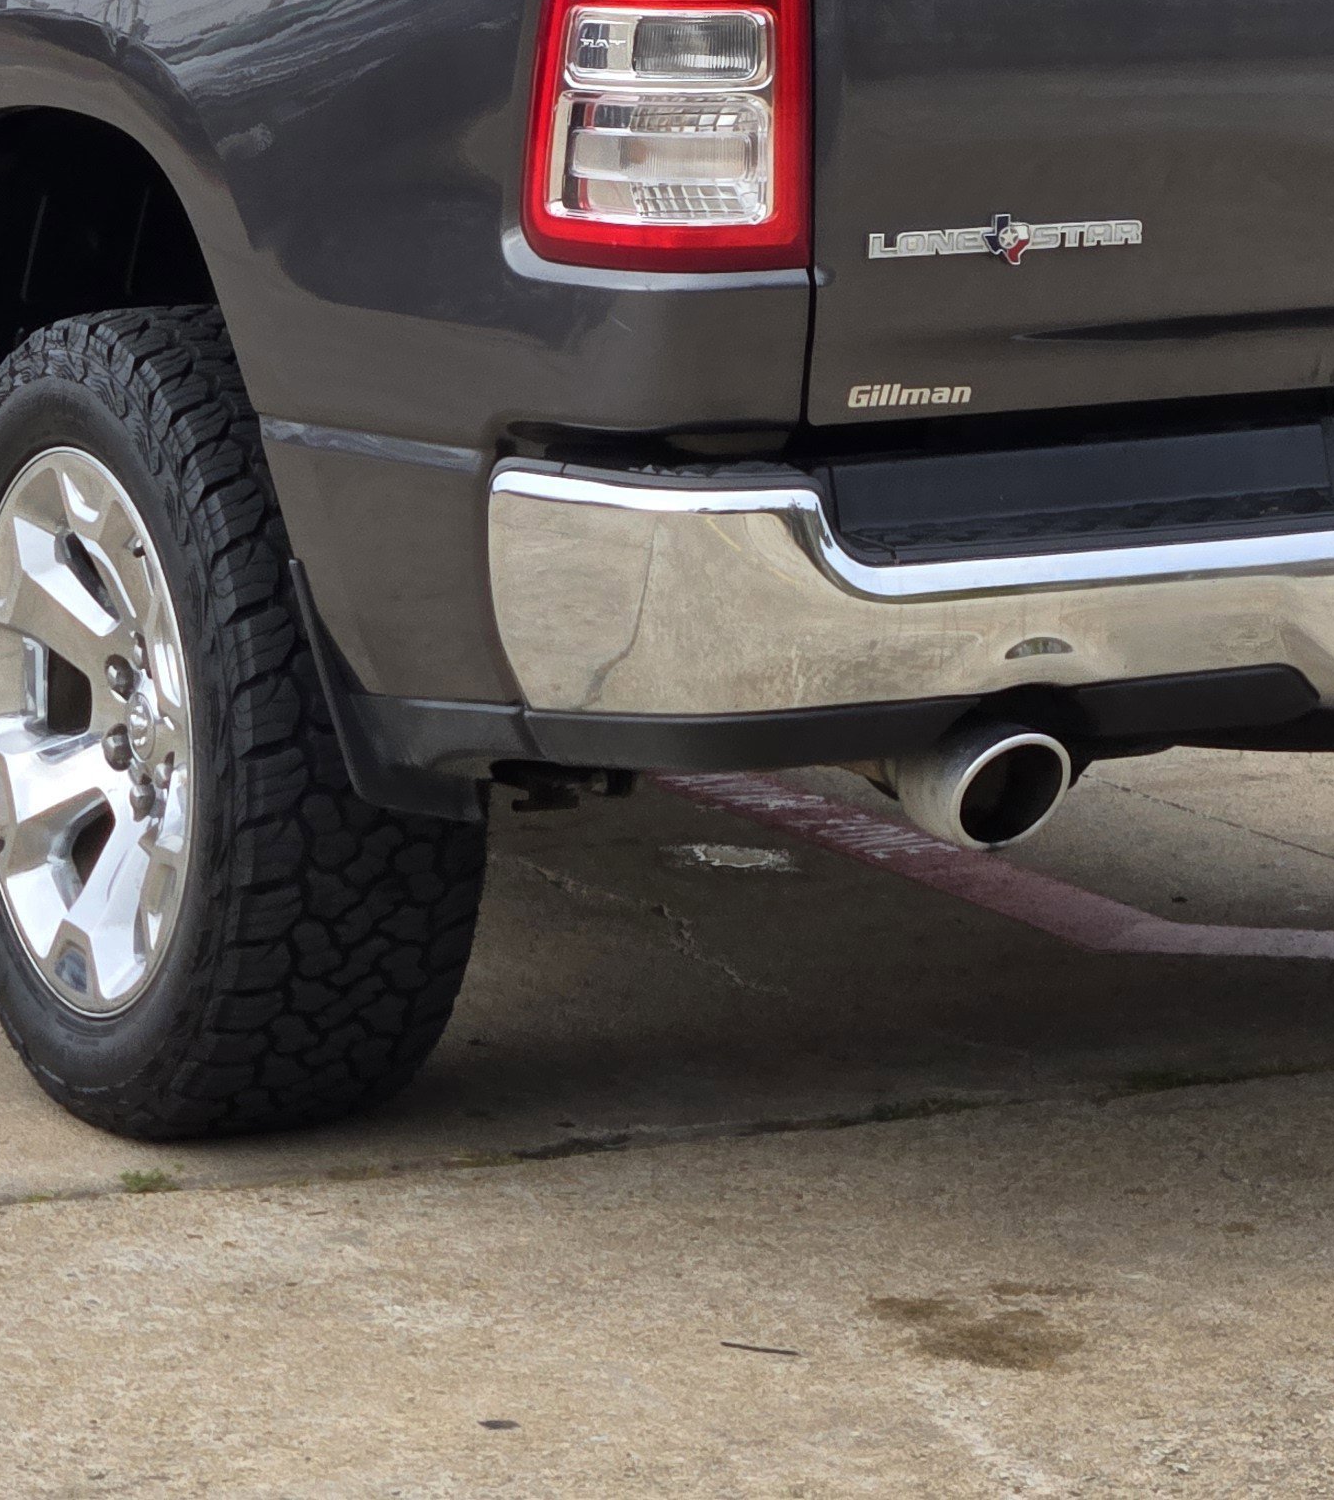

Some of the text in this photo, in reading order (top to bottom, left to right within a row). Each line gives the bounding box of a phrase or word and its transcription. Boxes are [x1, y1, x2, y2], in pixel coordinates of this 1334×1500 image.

[869, 220, 1143, 259] LONE STAR
[848, 384, 972, 408] Gillman
